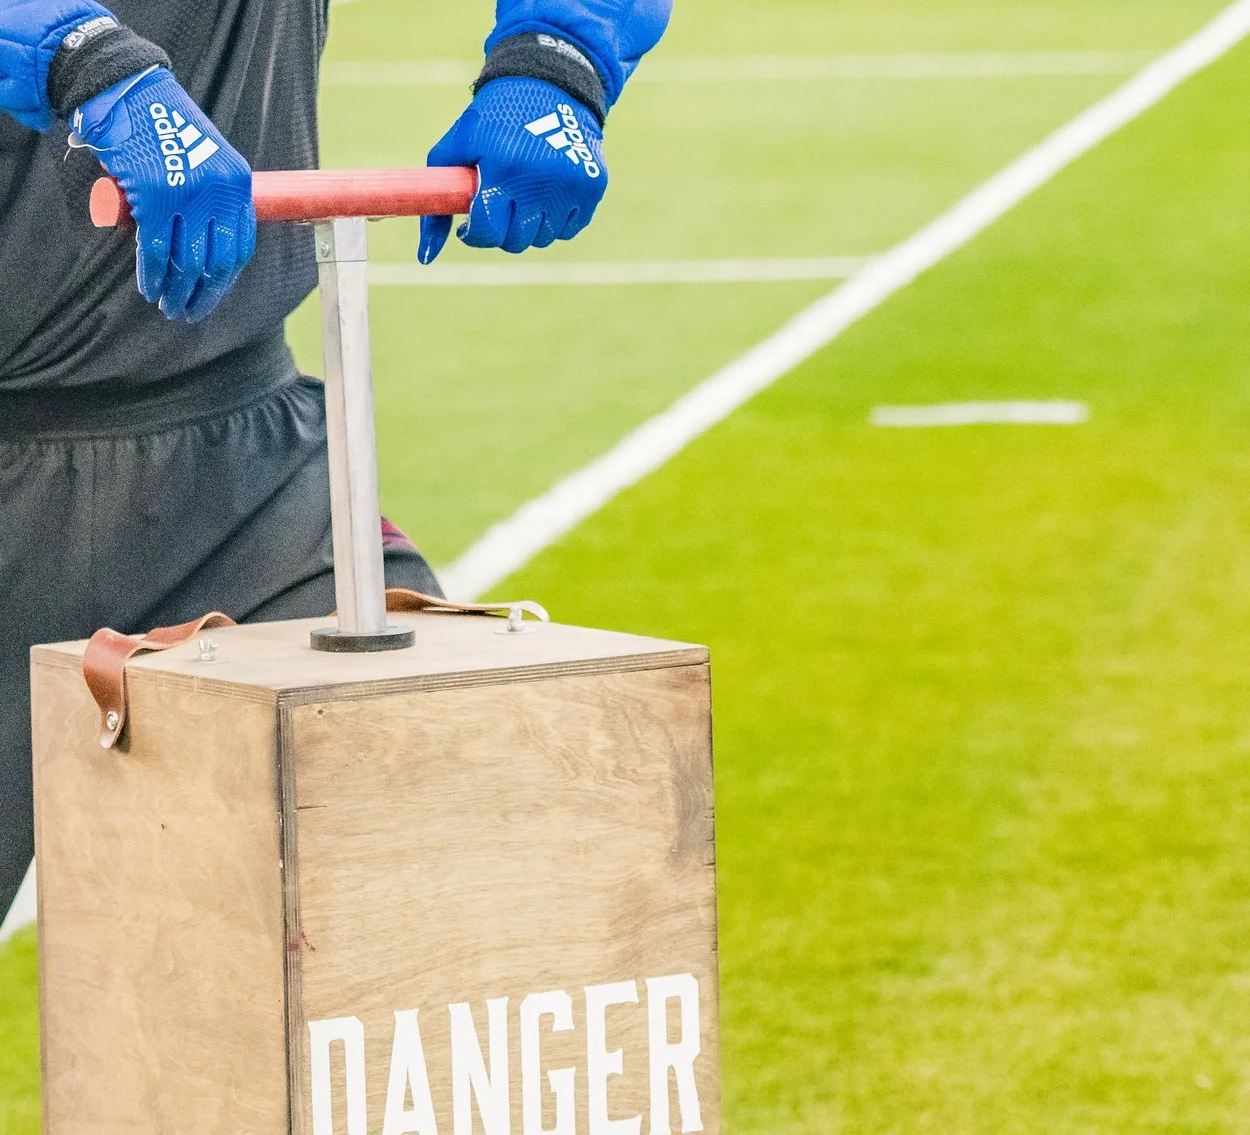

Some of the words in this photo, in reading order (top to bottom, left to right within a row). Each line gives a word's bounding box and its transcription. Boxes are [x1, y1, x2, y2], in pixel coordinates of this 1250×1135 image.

[150, 103, 186, 187] adidas
[557, 103, 601, 179] adidas
[308, 972, 704, 1135] DANGER
